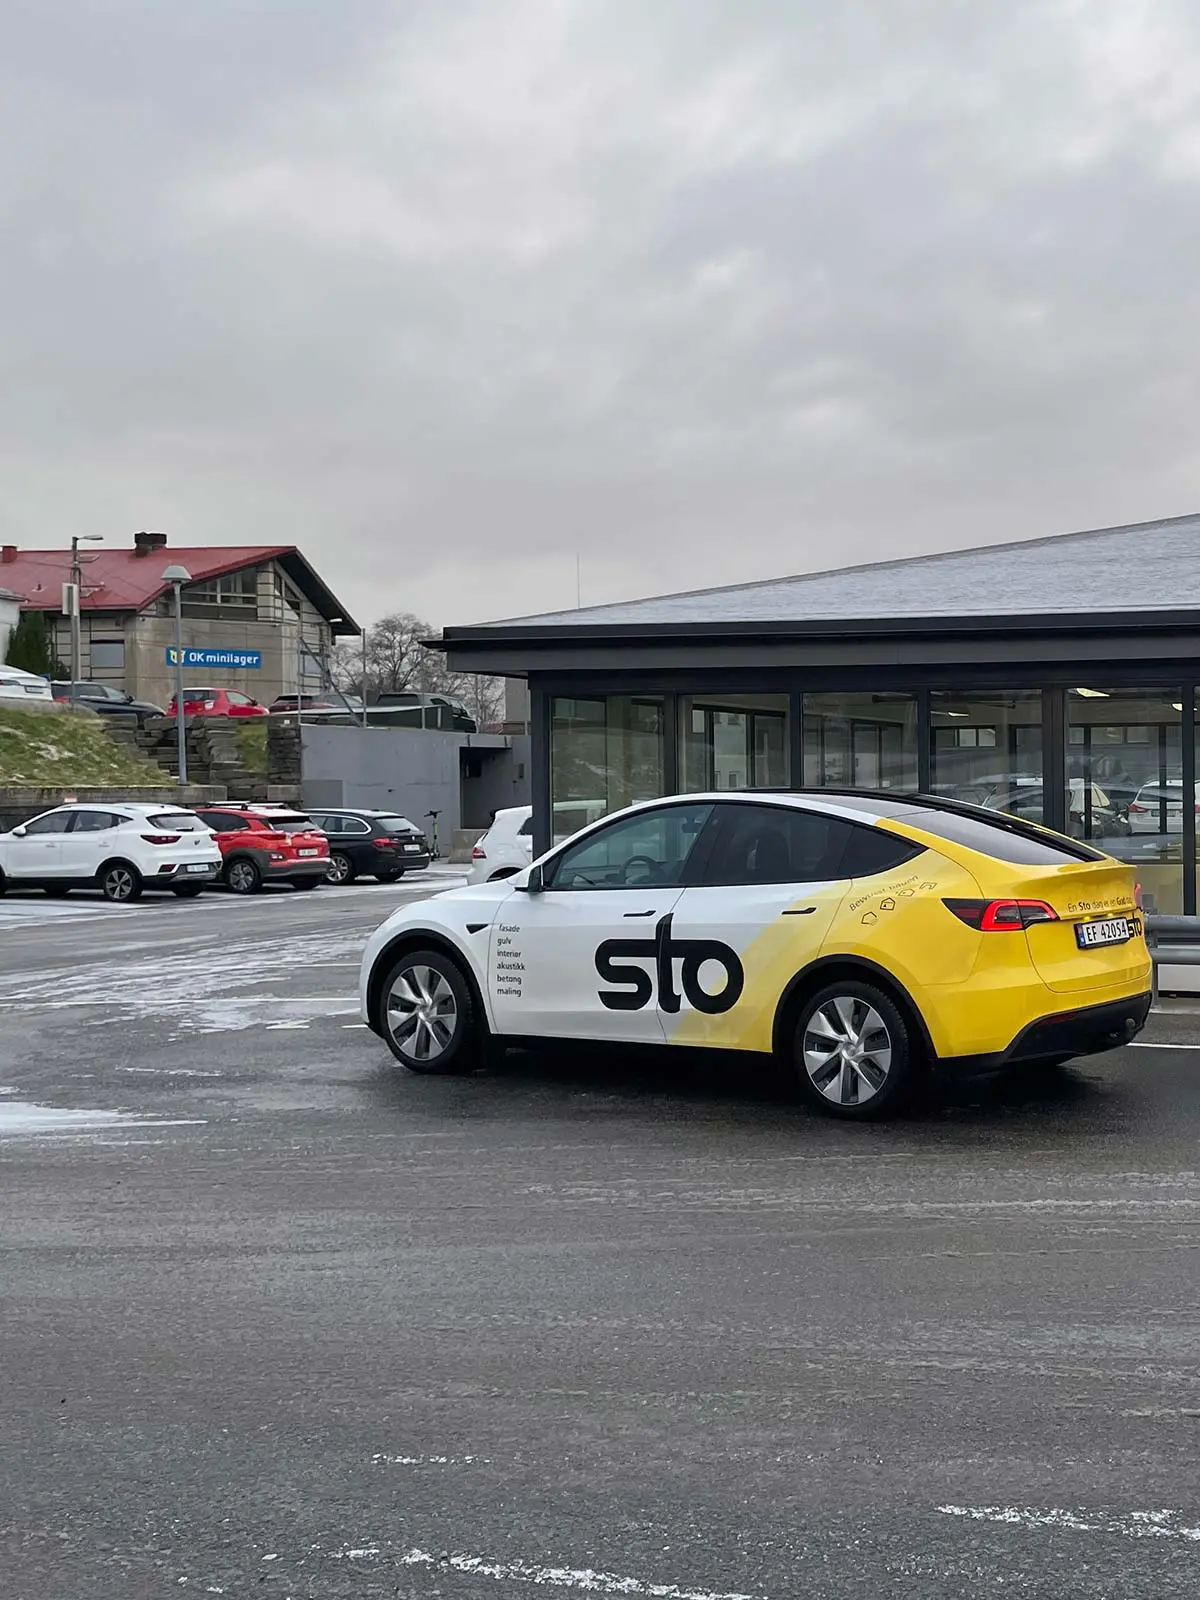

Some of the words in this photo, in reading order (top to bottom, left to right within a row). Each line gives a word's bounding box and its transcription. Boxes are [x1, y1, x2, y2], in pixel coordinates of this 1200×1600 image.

[189, 652, 204, 662] OK
[206, 653, 259, 666] minilager
[499, 923, 520, 932] fasade
[1086, 926, 1097, 942] EF
[1100, 922, 1127, 939] 42054
[497, 937, 512, 946] gulv
[595, 912, 745, 1014] sto
[497, 974, 522, 985] betong
[497, 987, 522, 997] maling
